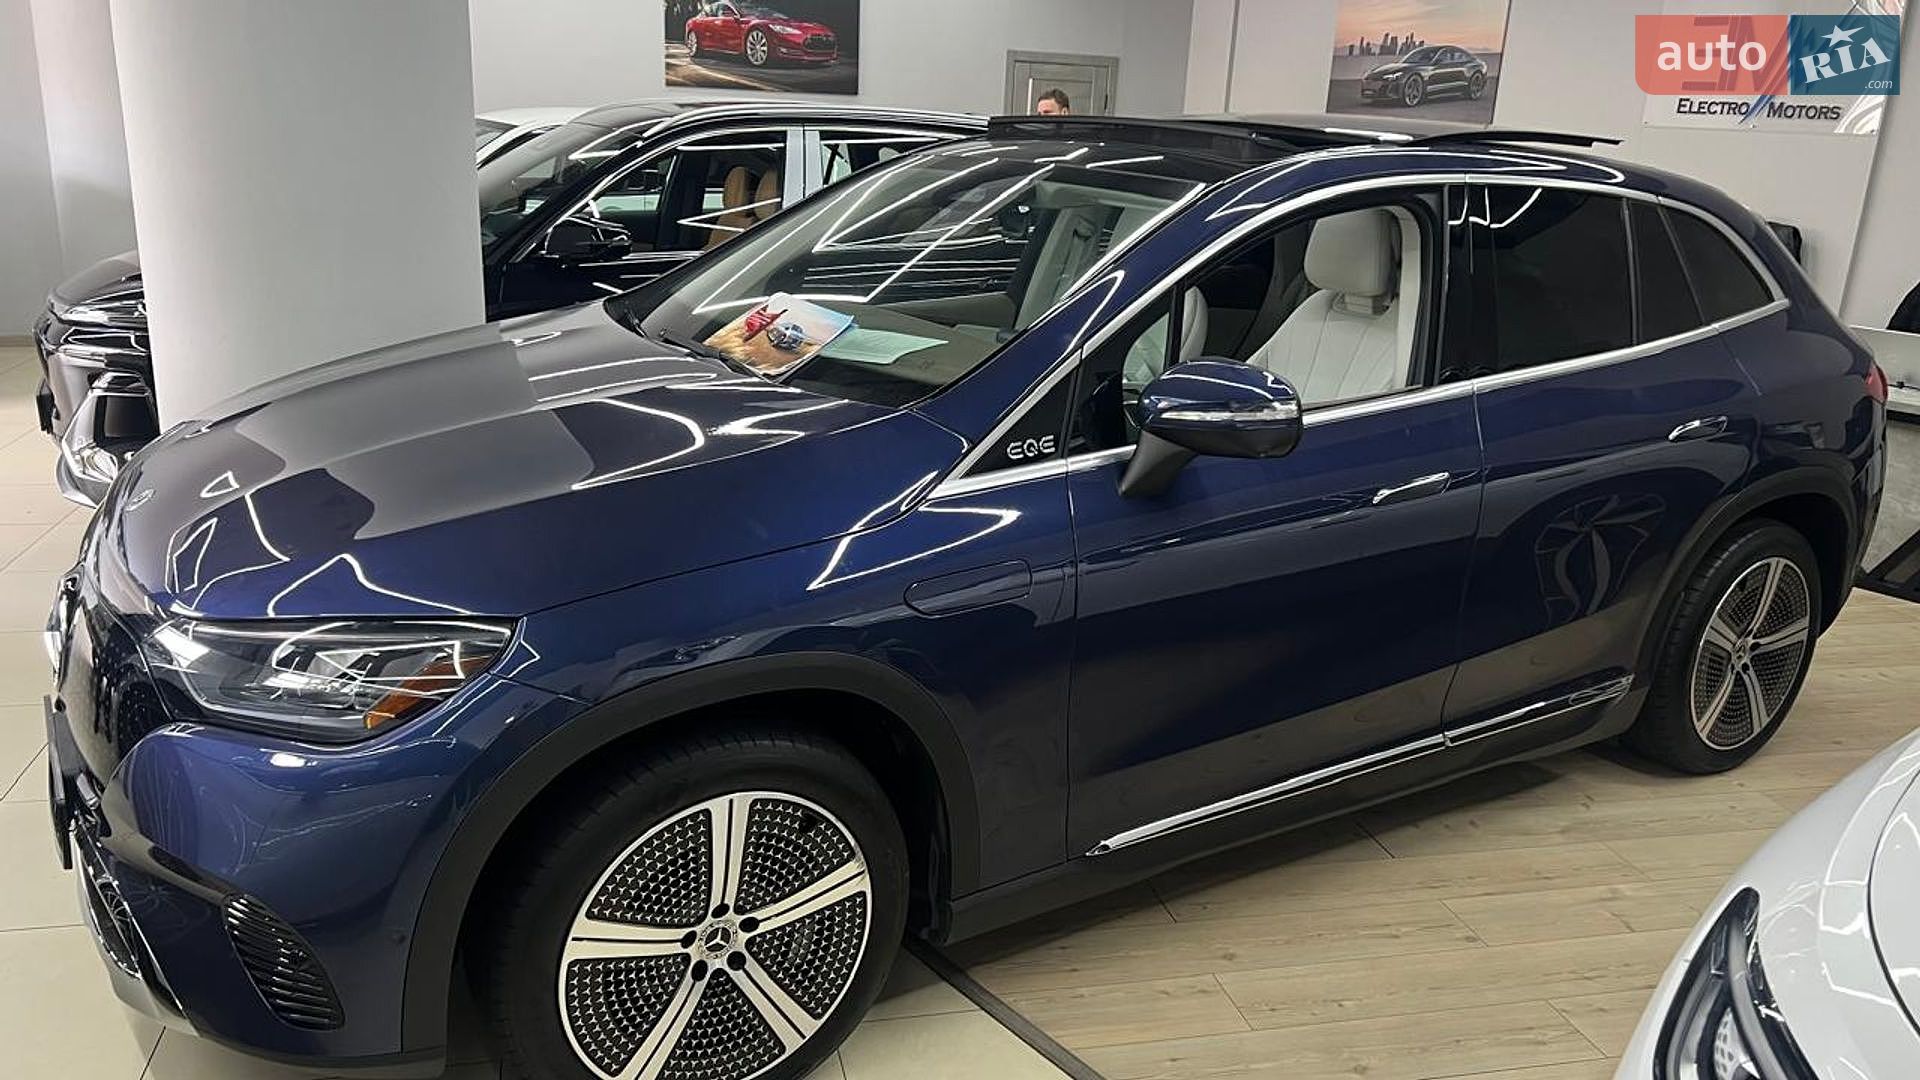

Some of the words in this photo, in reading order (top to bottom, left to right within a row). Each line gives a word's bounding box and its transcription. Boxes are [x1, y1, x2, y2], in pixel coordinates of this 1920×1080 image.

[1676, 97, 1750, 117] ELECTRO
[1766, 101, 1842, 121] MOTORS
[1006, 434, 1056, 460] EQE
